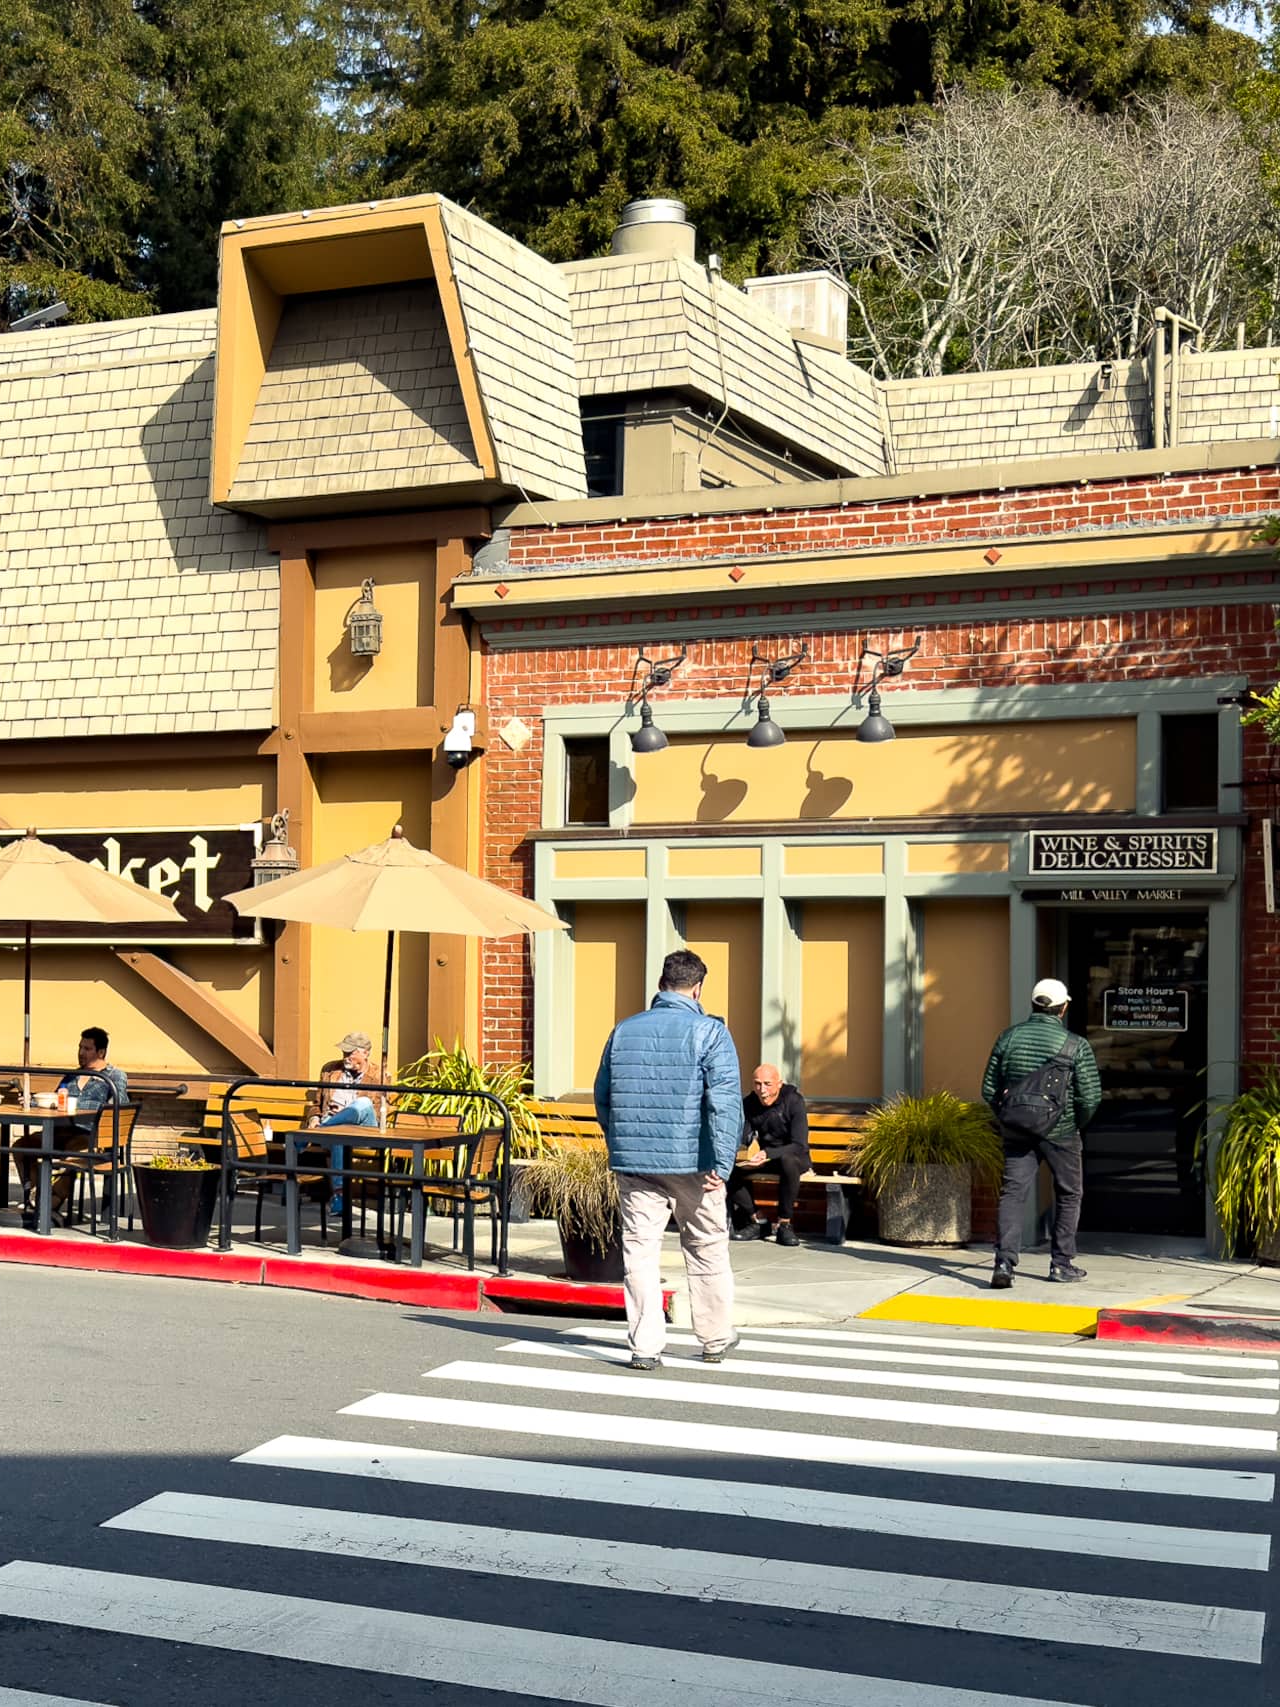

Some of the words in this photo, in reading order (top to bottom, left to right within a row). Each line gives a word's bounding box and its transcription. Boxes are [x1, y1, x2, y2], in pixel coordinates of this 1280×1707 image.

[1040, 837, 1098, 851] WINE
[1104, 836, 1123, 850] &
[1128, 835, 1207, 850] SPIRITS
[1039, 850, 1207, 868] DELICATESSEN
[1061, 890, 1085, 901] MILL
[1091, 890, 1129, 901] VALLEY
[1137, 889, 1183, 901] MARKET
[1118, 987, 1144, 996] Store
[1145, 987, 1174, 996] Hours
[1133, 1012, 1159, 1020] Sunday
